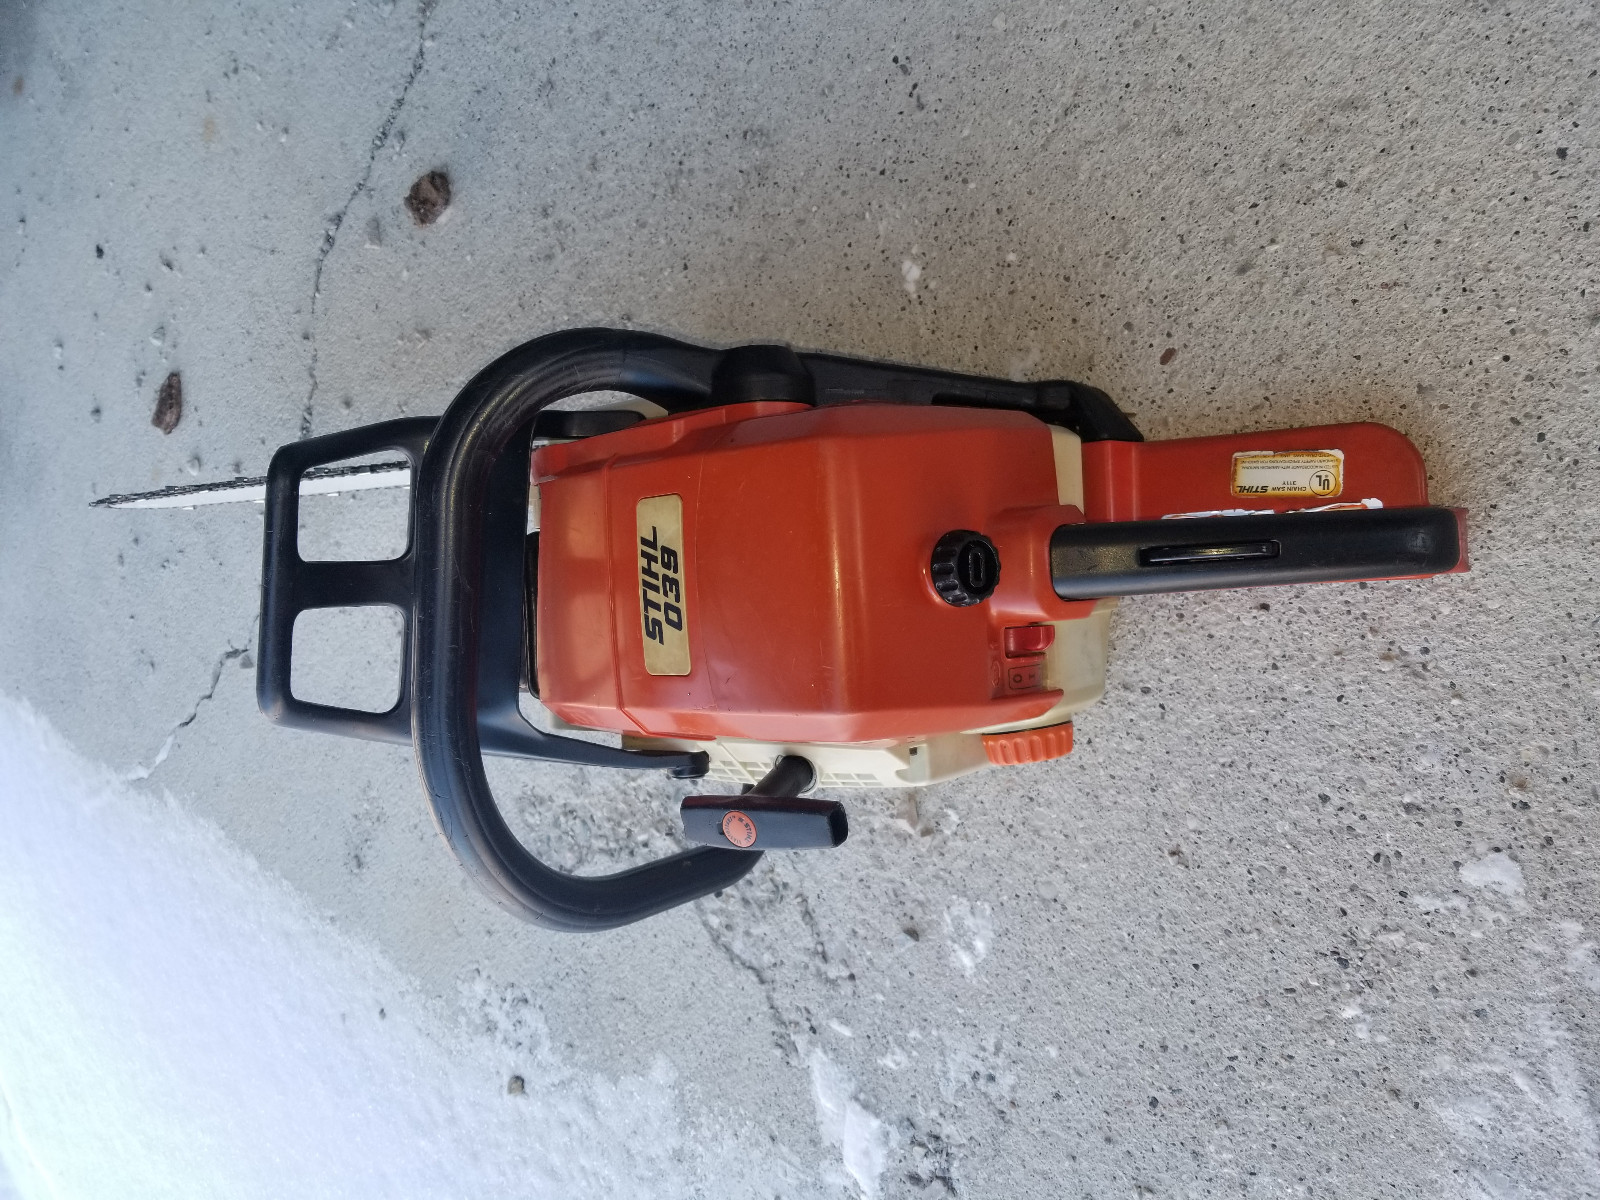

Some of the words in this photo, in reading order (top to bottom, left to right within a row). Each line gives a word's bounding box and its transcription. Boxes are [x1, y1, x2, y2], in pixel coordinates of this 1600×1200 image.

[1236, 485, 1269, 493] STIHL
[640, 526, 665, 645] STIHL
[660, 545, 683, 631] 039
